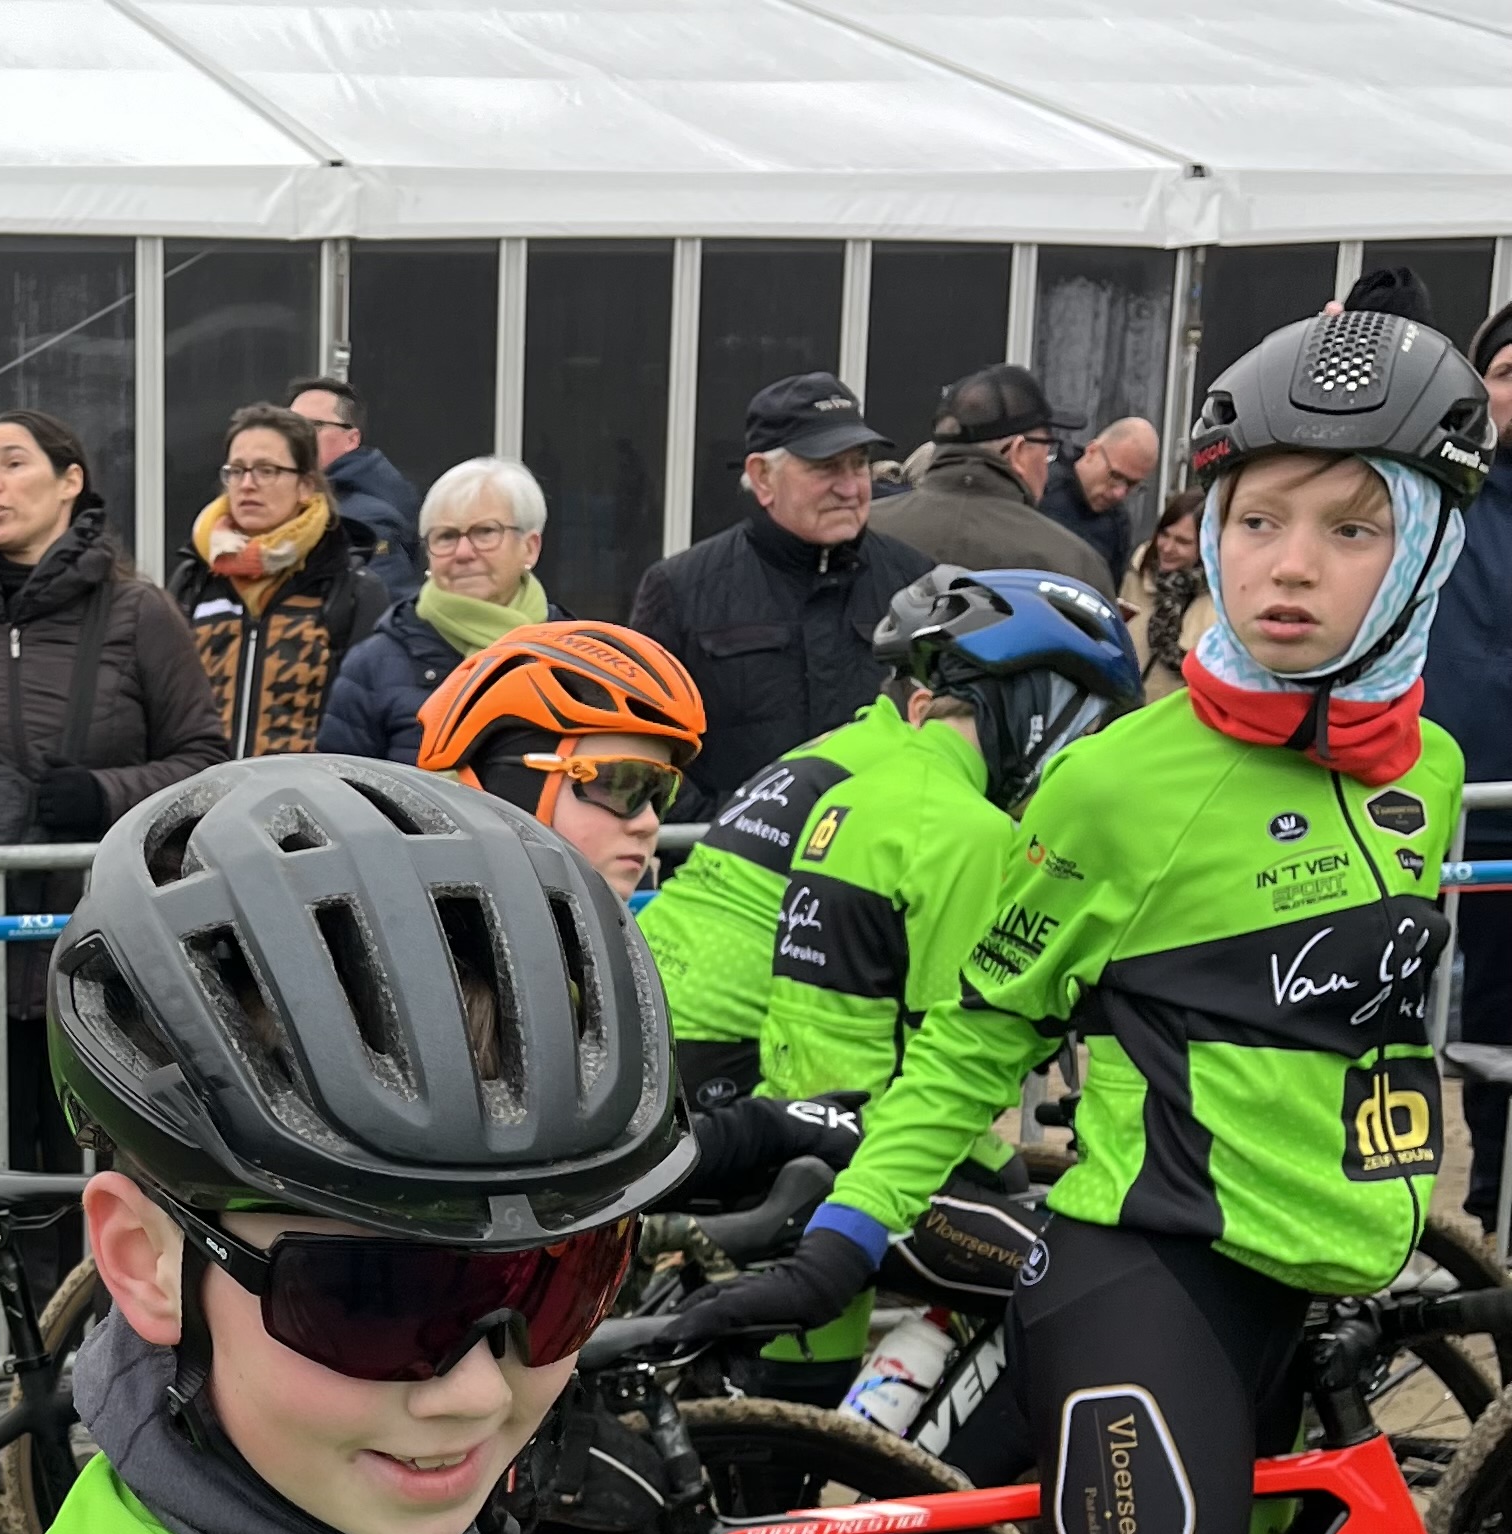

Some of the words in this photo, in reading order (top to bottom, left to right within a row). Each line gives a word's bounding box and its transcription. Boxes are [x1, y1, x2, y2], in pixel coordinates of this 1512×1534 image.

[1256, 869, 1278, 889] IN
[1304, 852, 1350, 875] VEN
[1273, 872, 1346, 904] SPORT
[1001, 903, 1060, 949] INE
[1271, 927, 1362, 1006] Van
